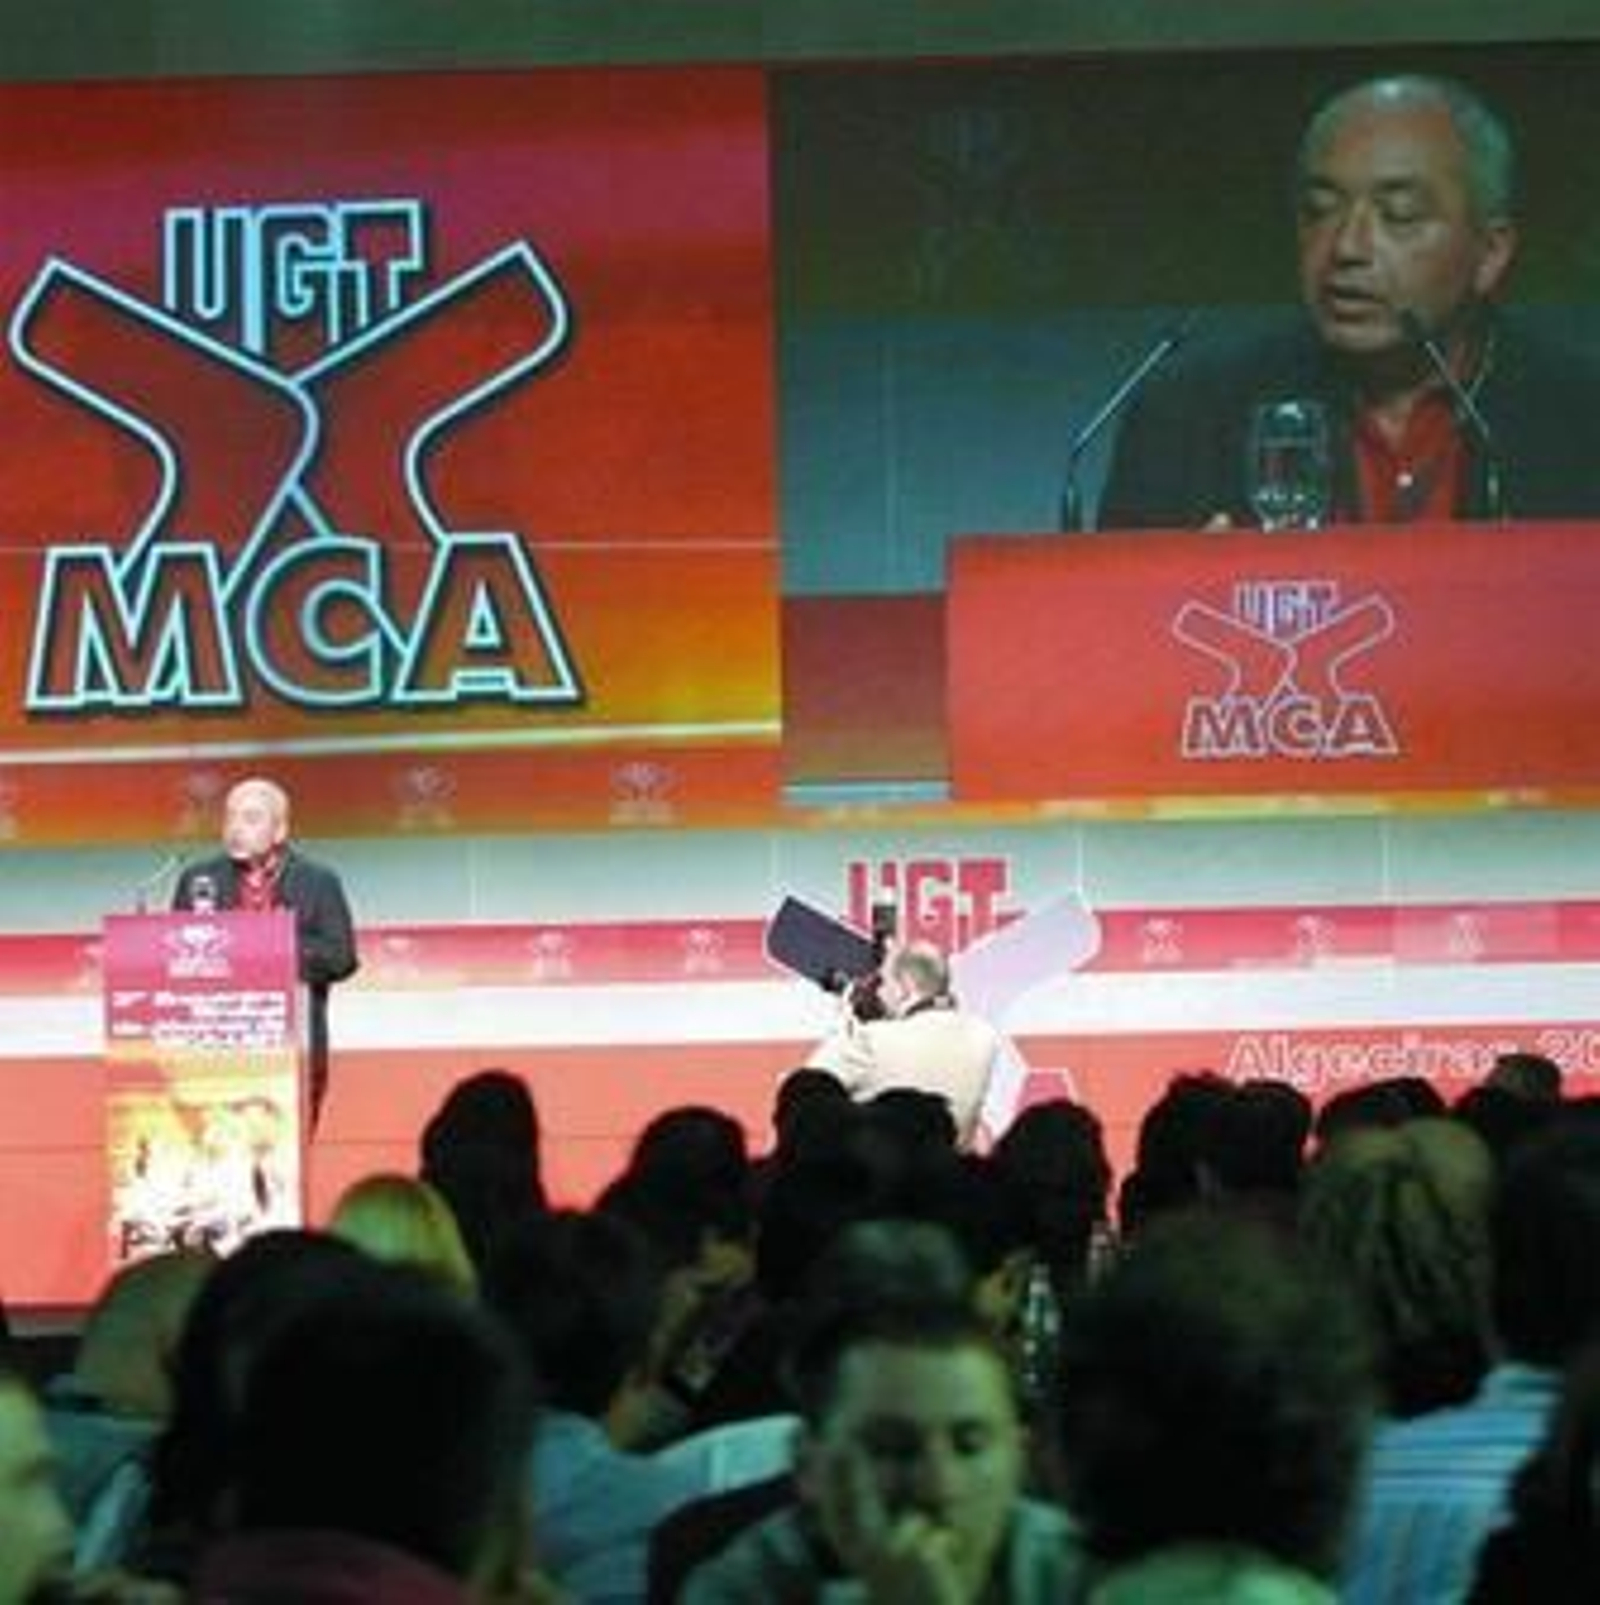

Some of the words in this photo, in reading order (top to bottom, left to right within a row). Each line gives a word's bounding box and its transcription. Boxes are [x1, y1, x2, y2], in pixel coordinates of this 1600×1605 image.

[164, 199, 422, 356] UGT
[25, 532, 579, 707] MCA
[1234, 580, 1338, 636] UGT
[1181, 692, 1399, 758] MCA
[1224, 1031, 1519, 1093] Algecira
